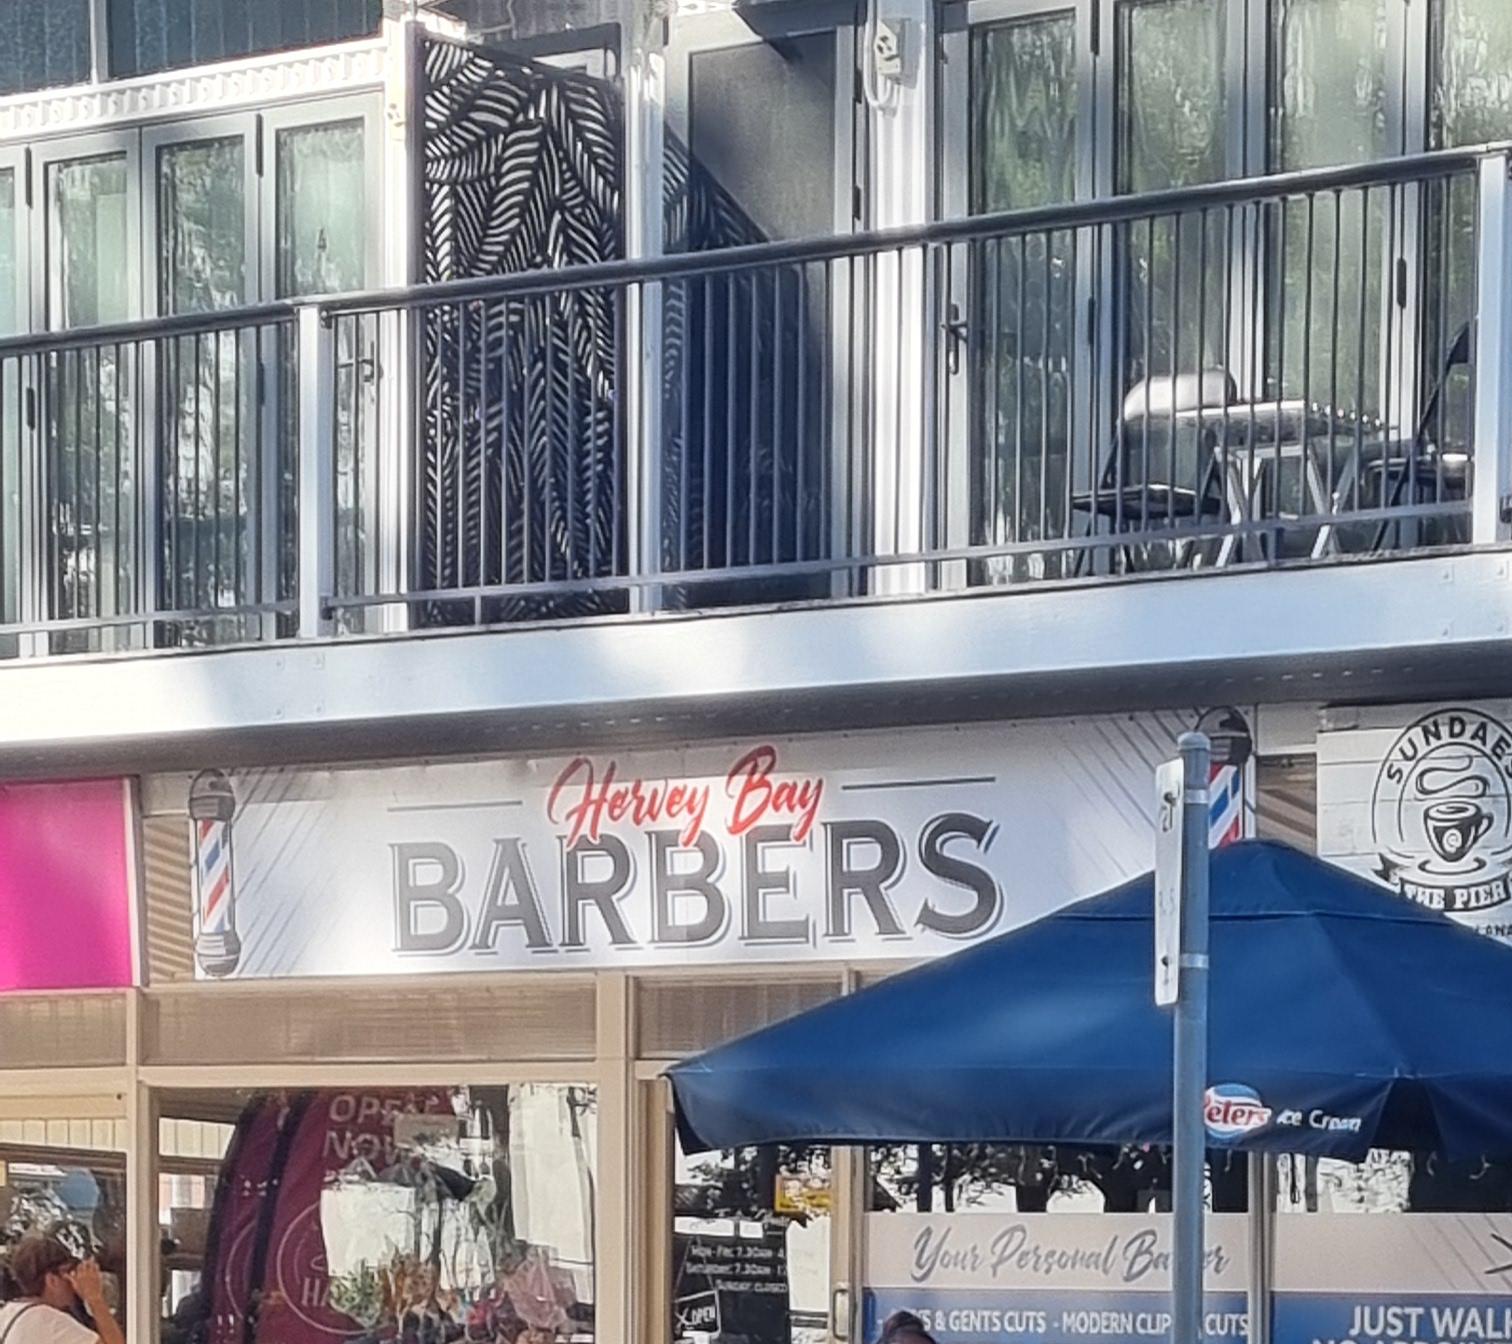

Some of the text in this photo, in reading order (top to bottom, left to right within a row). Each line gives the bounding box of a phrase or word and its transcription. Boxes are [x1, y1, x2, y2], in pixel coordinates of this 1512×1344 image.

[548, 745, 824, 848] Hervey Bay
[388, 811, 1003, 955] BARBERS
[1454, 881, 1508, 908] PIER
[910, 1224, 1231, 1283] Your Personal Baer
[949, 1311, 1004, 1332] GENTS
[1004, 1312, 1047, 1334] CUTS
[1062, 1311, 1133, 1334] MODERN
[1349, 1305, 1424, 1337] JUST
